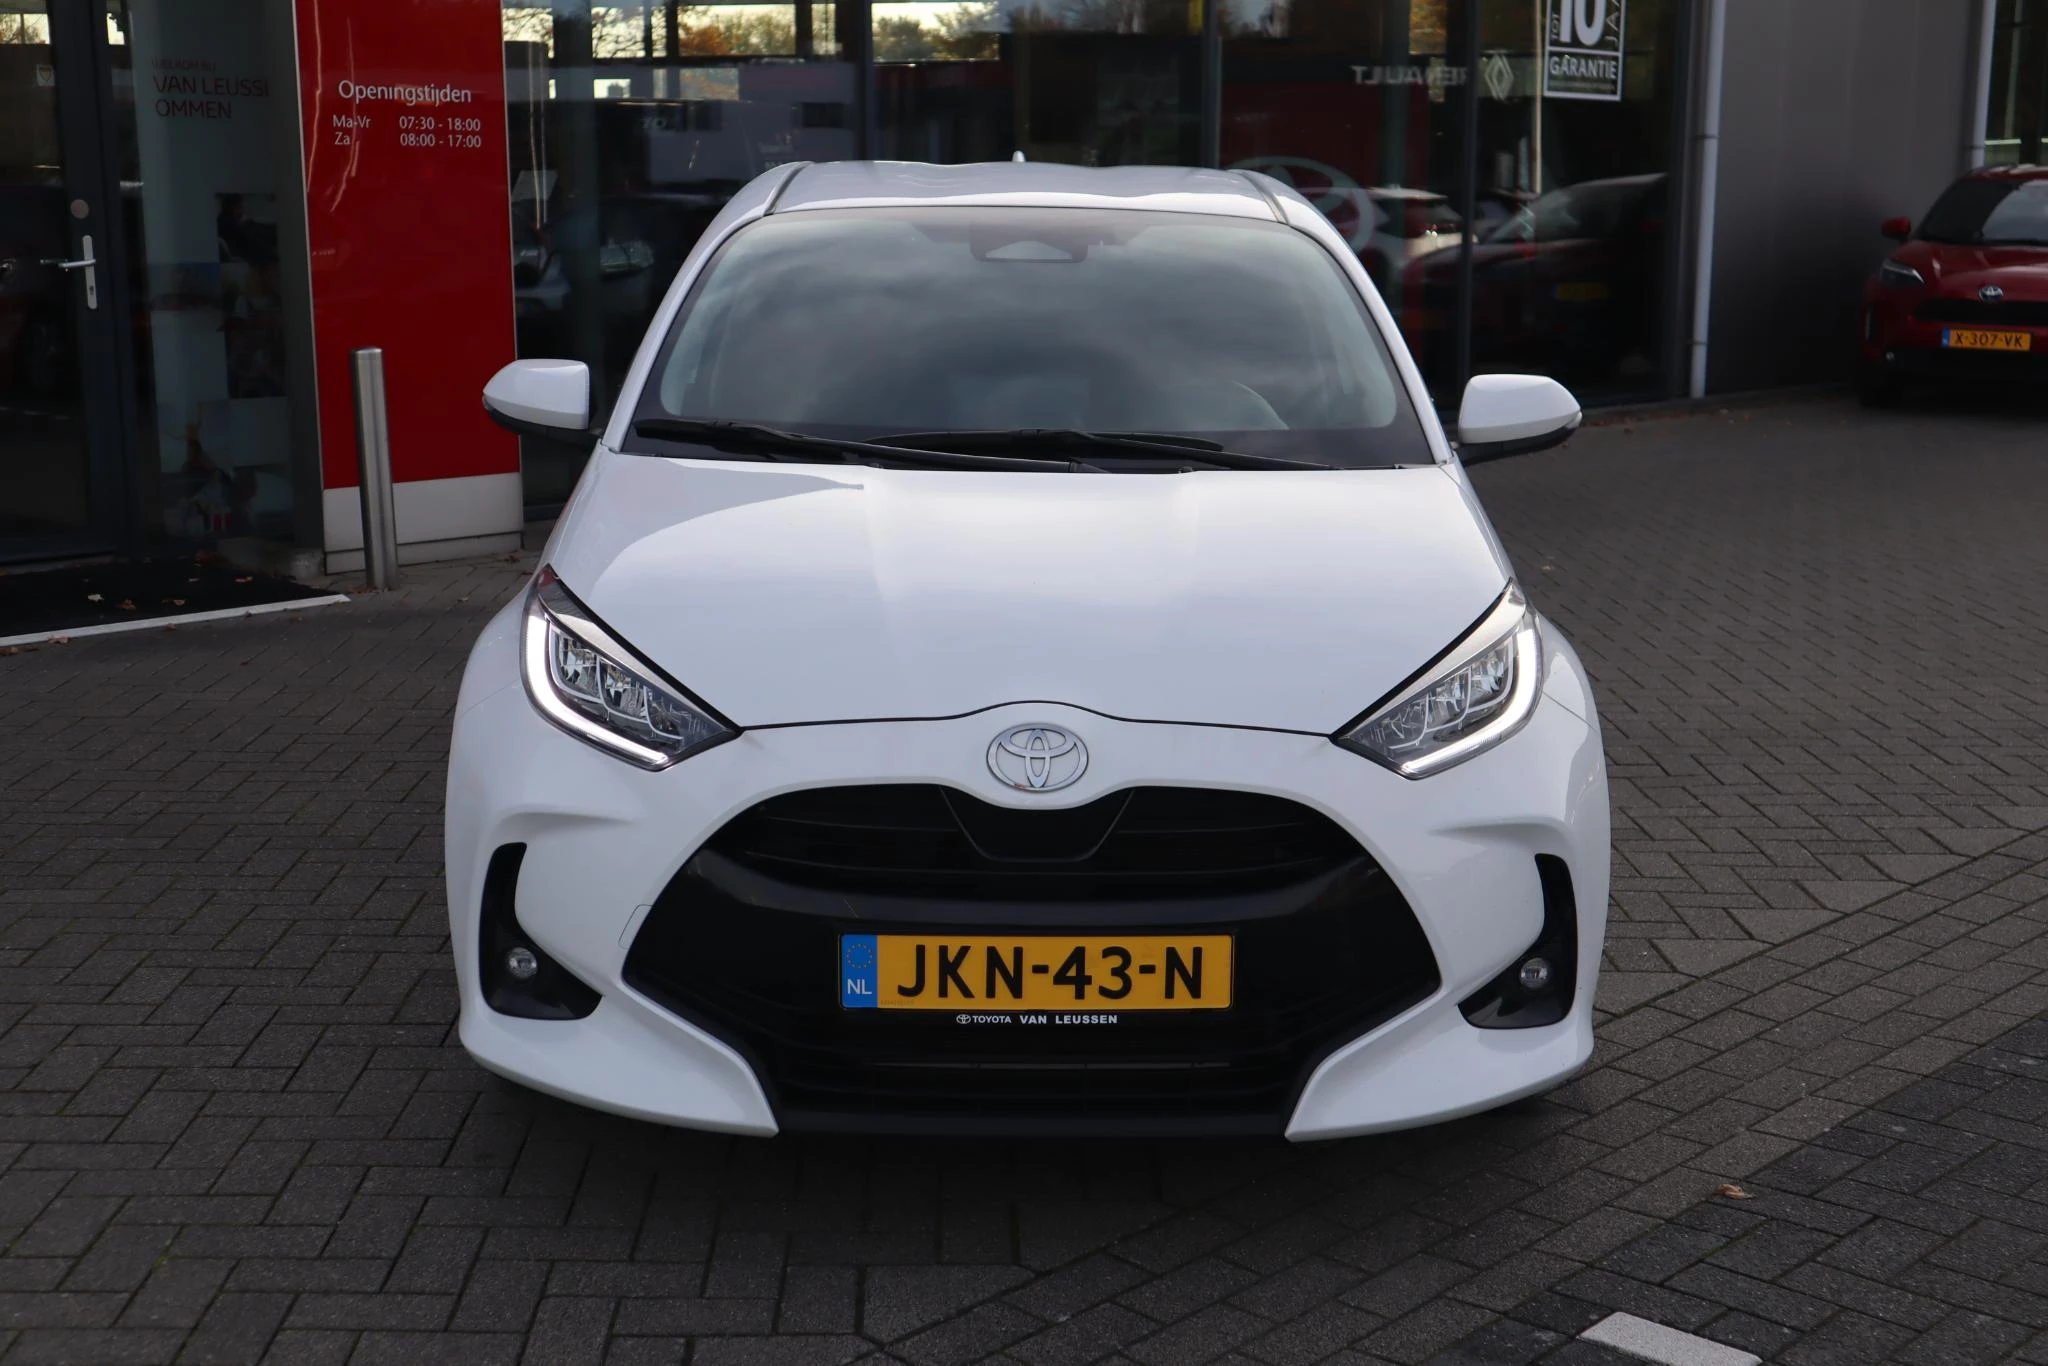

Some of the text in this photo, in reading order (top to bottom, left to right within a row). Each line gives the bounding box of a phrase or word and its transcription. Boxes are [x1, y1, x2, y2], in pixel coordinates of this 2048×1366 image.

[1559, 0, 1607, 46] 10
[1549, 55, 1618, 80] GARANTIE
[153, 75, 197, 94] VAN
[338, 80, 472, 107] Openingstijden
[155, 99, 233, 119] OMMEN
[332, 114, 371, 129] Ma-Vr
[399, 116, 434, 130] 07:30
[447, 117, 481, 131] 18:00
[334, 131, 352, 145] Za
[400, 133, 435, 147] 08:00
[448, 134, 481, 148] 17:00
[1955, 331, 2023, 348] X-307-VK
[897, 944, 1203, 1001] JKN-43-N
[847, 978, 872, 995] NL
[972, 1014, 1118, 1024] TOYOTA VAN LEUSSEN
